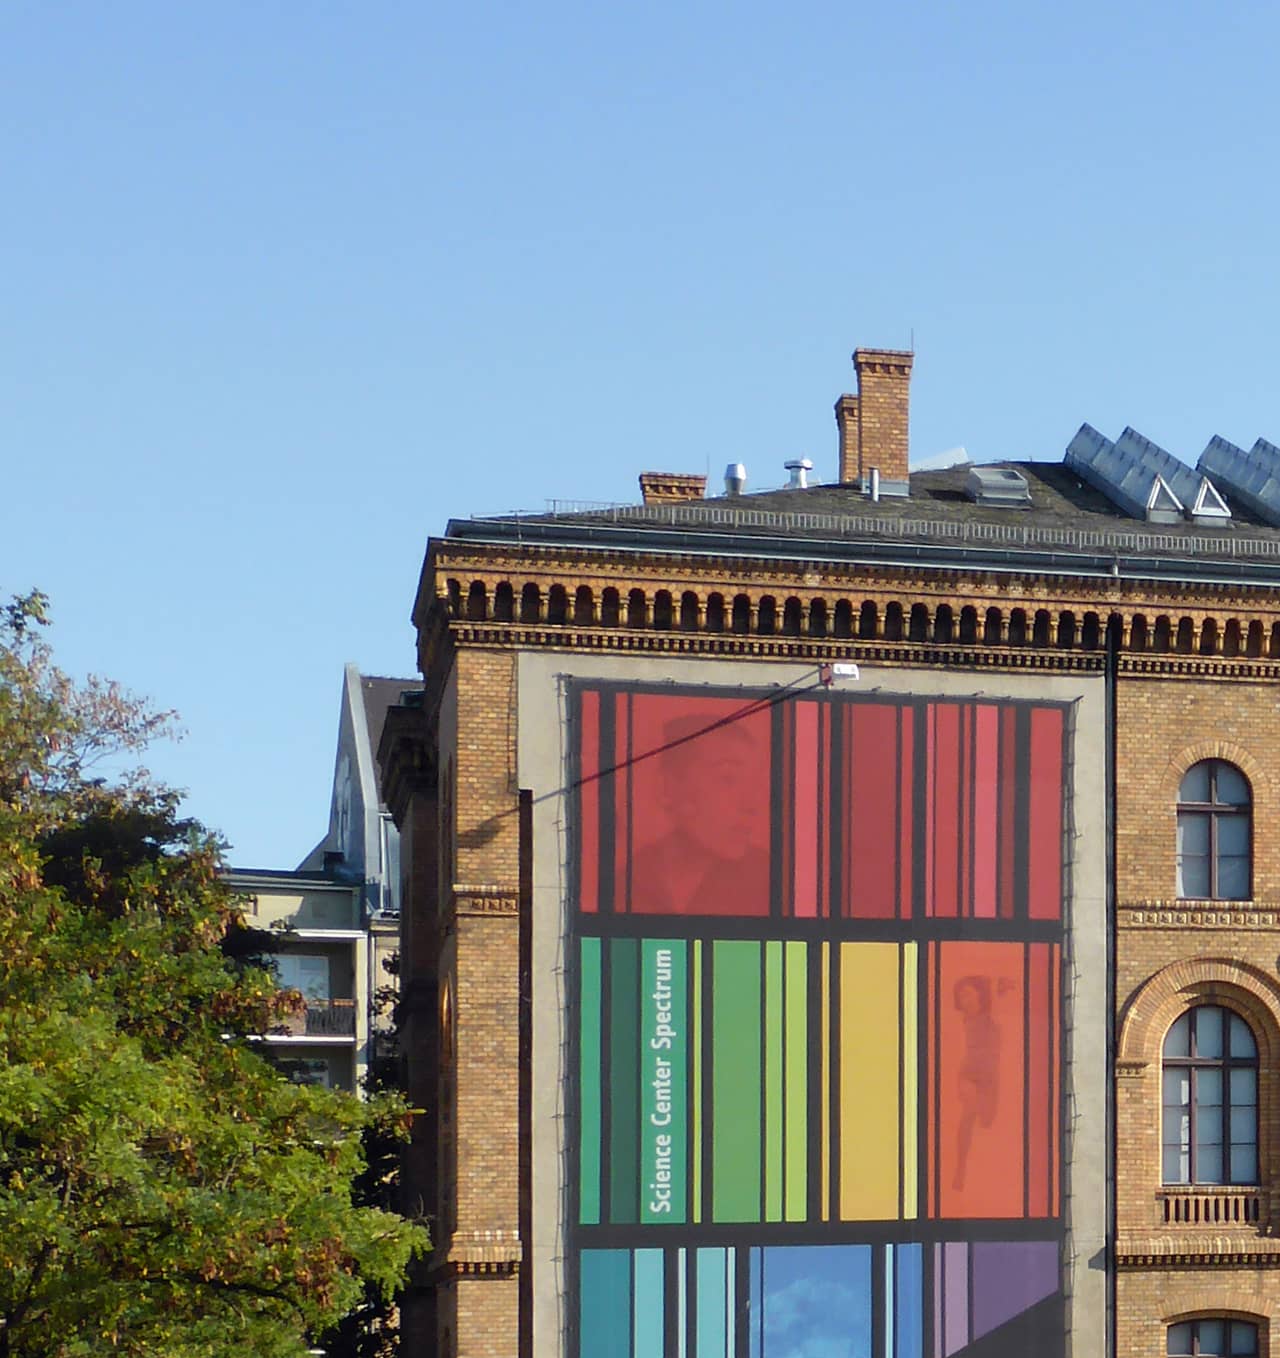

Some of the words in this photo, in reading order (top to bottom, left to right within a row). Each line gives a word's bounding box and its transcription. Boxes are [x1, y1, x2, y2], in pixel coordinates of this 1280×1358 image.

[651, 949, 677, 1050] Spectrum
[651, 1057, 672, 1126] Center
[650, 1134, 672, 1213] Science
